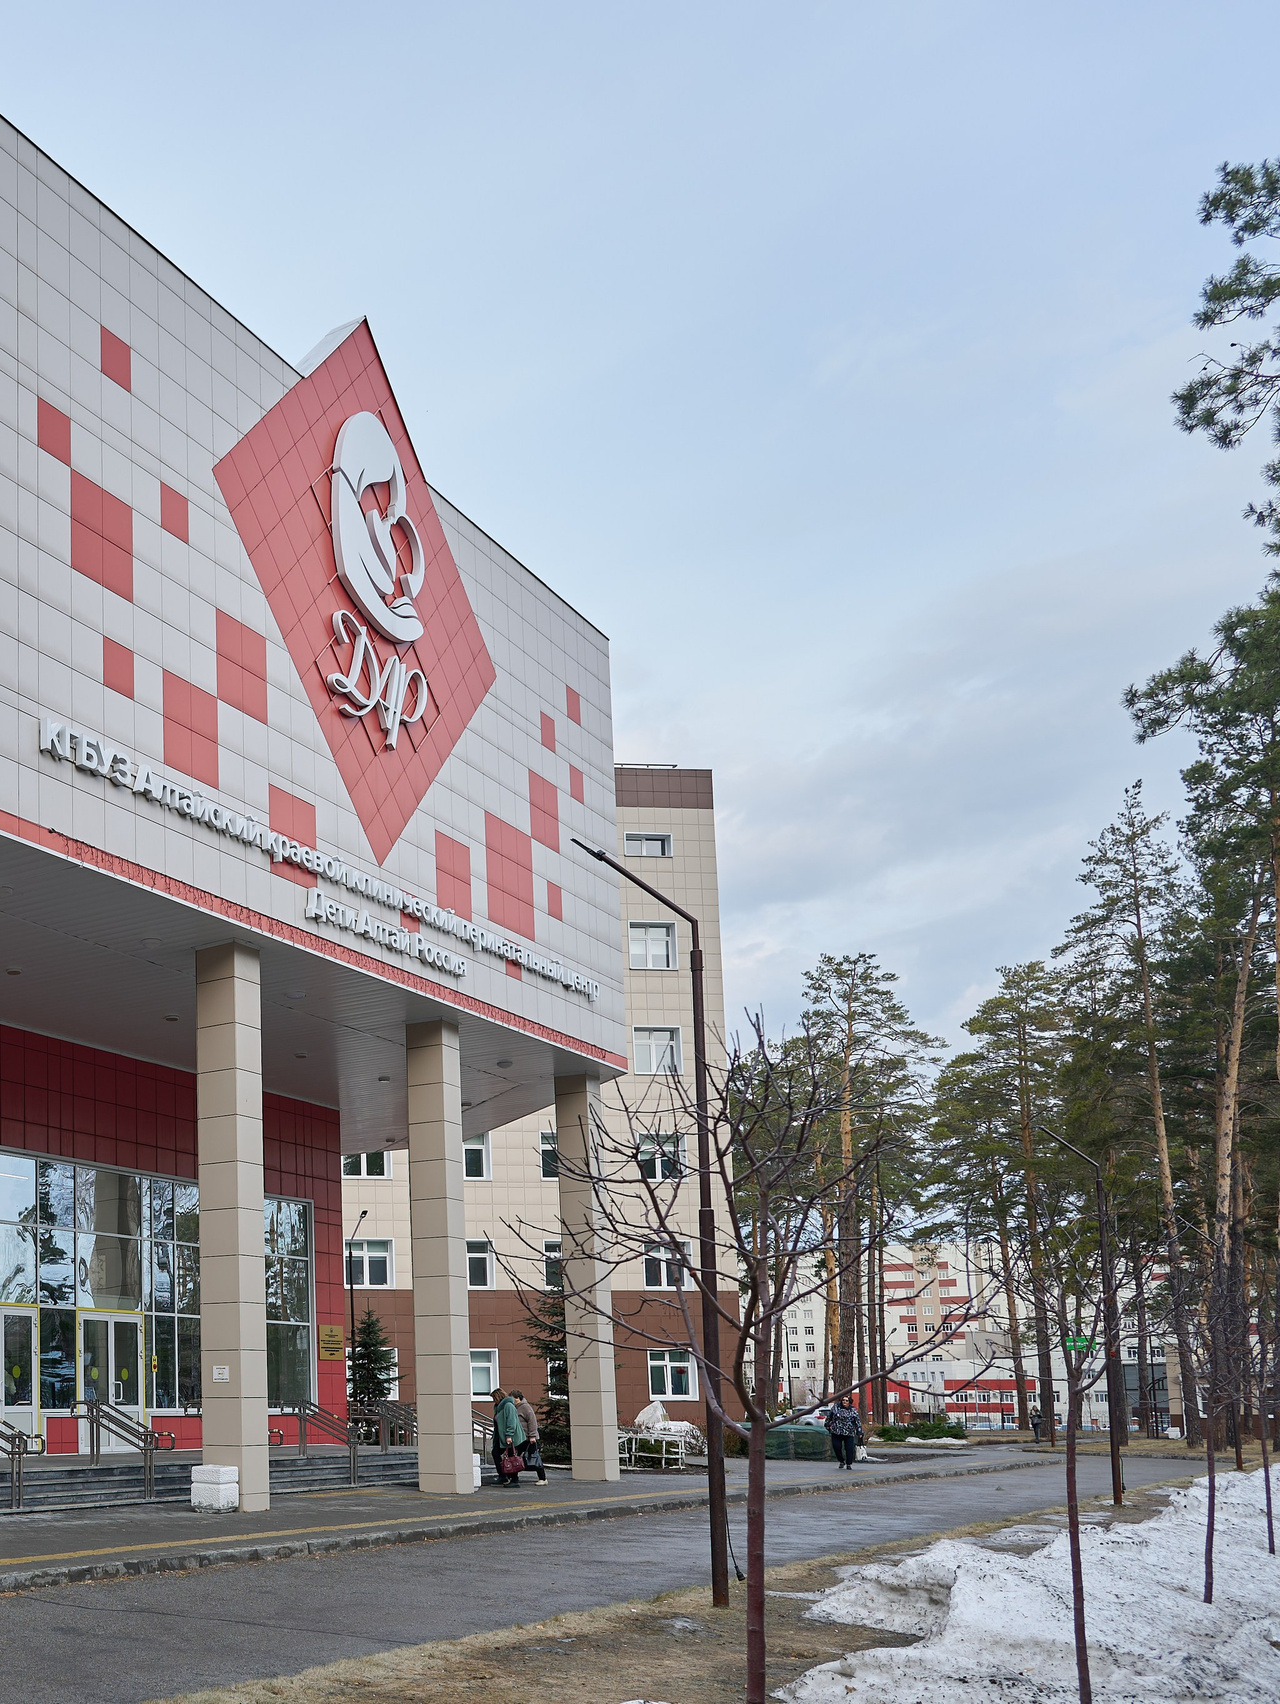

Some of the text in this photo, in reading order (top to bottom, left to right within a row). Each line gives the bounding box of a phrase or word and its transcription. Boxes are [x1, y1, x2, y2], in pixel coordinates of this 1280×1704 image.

[39, 716, 600, 1003] КГБУЗ Алтайский краевой клинический перинатальный центр
[305, 886, 468, 978] Дети Алтай Россия
